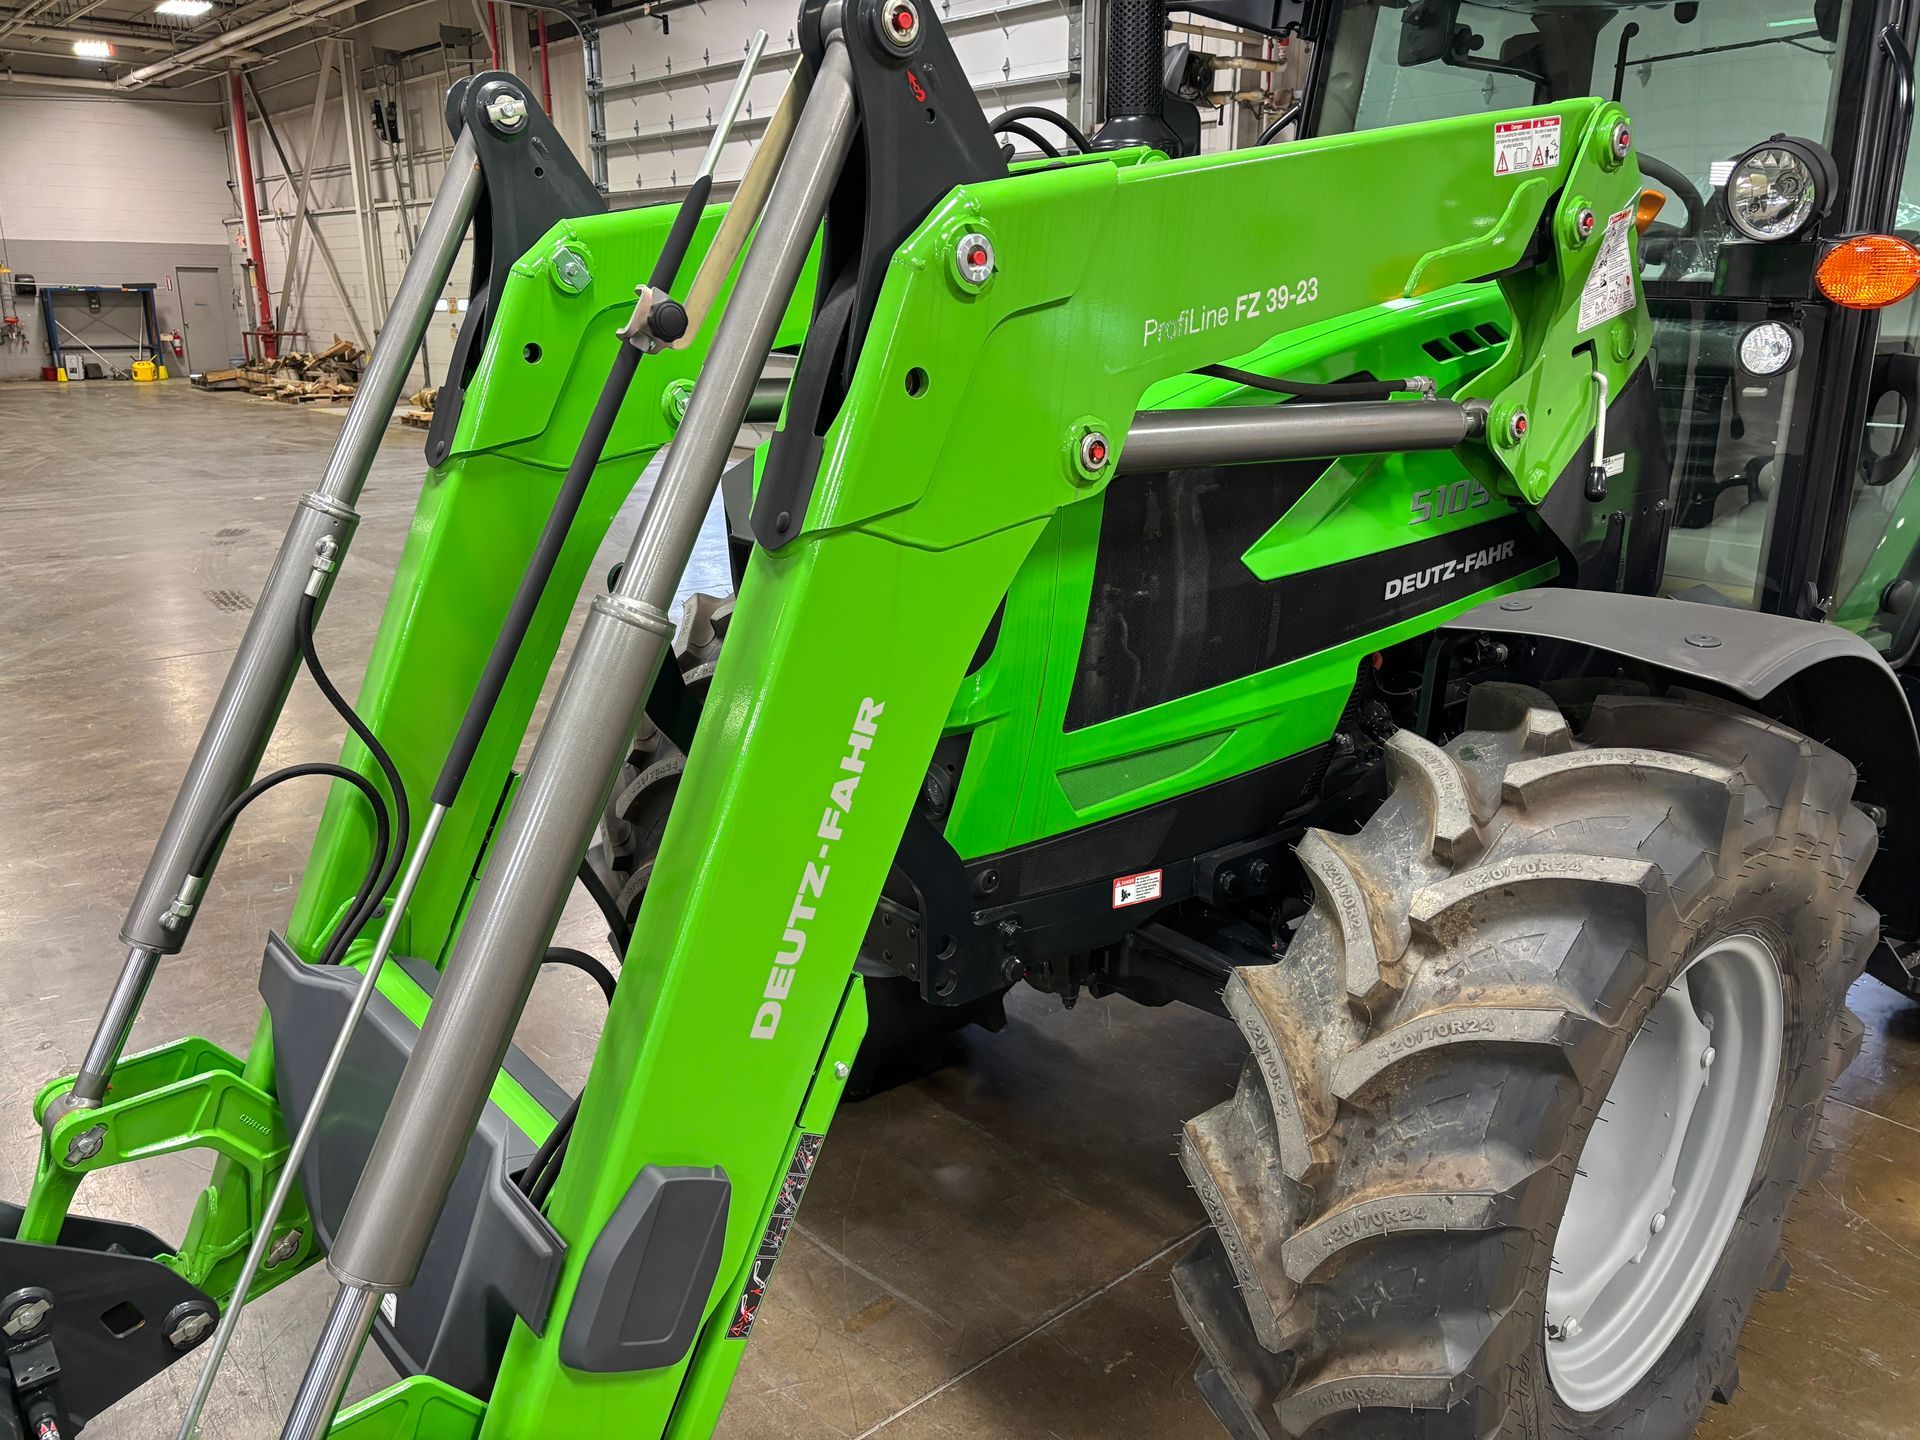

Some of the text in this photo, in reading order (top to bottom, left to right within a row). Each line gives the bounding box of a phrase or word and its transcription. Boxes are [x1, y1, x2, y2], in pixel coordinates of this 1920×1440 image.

[1143, 277, 1318, 347] ProfiLine FZ 39-23
[1384, 540, 1515, 601] DEUTZ-FAHR
[750, 696, 885, 1040] DEUTZ-FAHR
[1463, 859, 1584, 892] 420/70R24
[1245, 1016, 1292, 1121] 420/70R24
[1376, 1016, 1497, 1060] 420/70R24
[1320, 1204, 1428, 1249] 420/70R24
